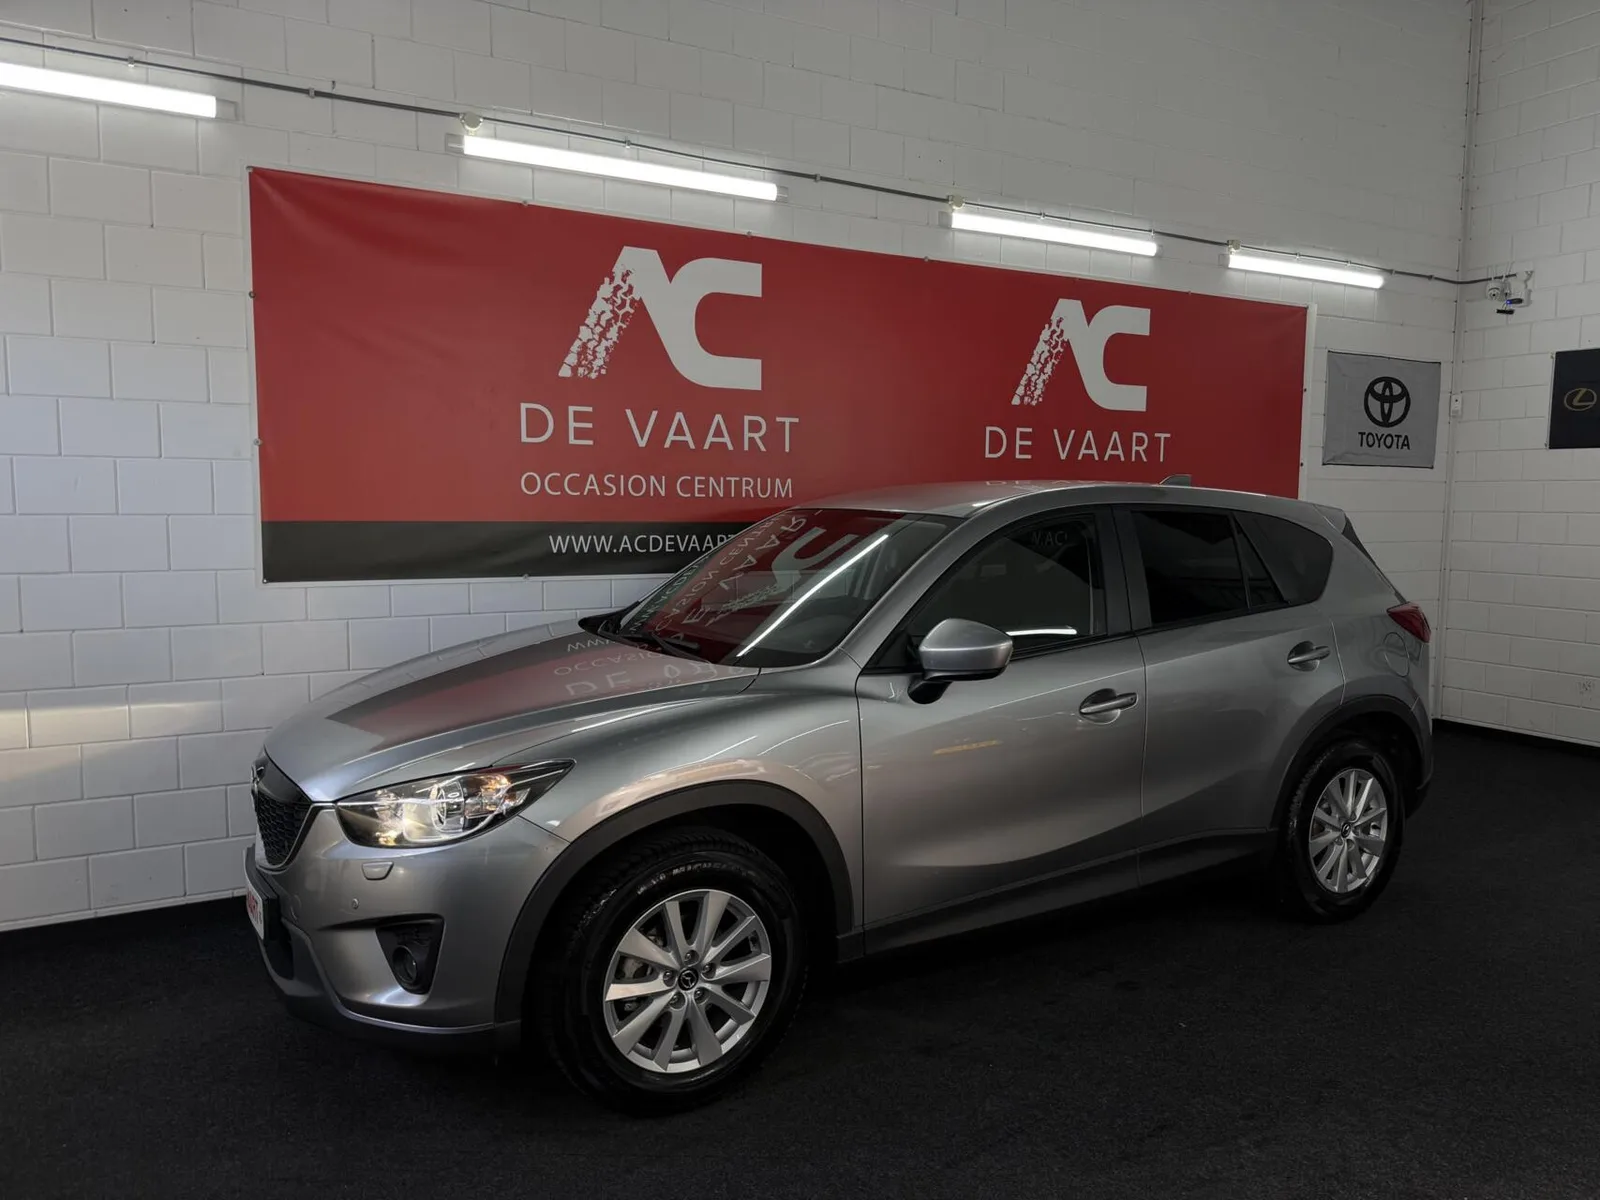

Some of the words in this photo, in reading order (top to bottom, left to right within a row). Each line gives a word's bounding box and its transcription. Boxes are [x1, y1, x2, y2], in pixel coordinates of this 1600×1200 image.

[558, 246, 762, 391] AC
[1011, 298, 1150, 412] AC
[520, 402, 593, 445] DE
[625, 408, 799, 453] VAART
[985, 426, 1033, 459] DE
[1053, 429, 1171, 462] VAART
[1358, 432, 1411, 450] TOYOTA
[520, 472, 666, 497] OCCASION
[676, 475, 793, 499] CENTRUM
